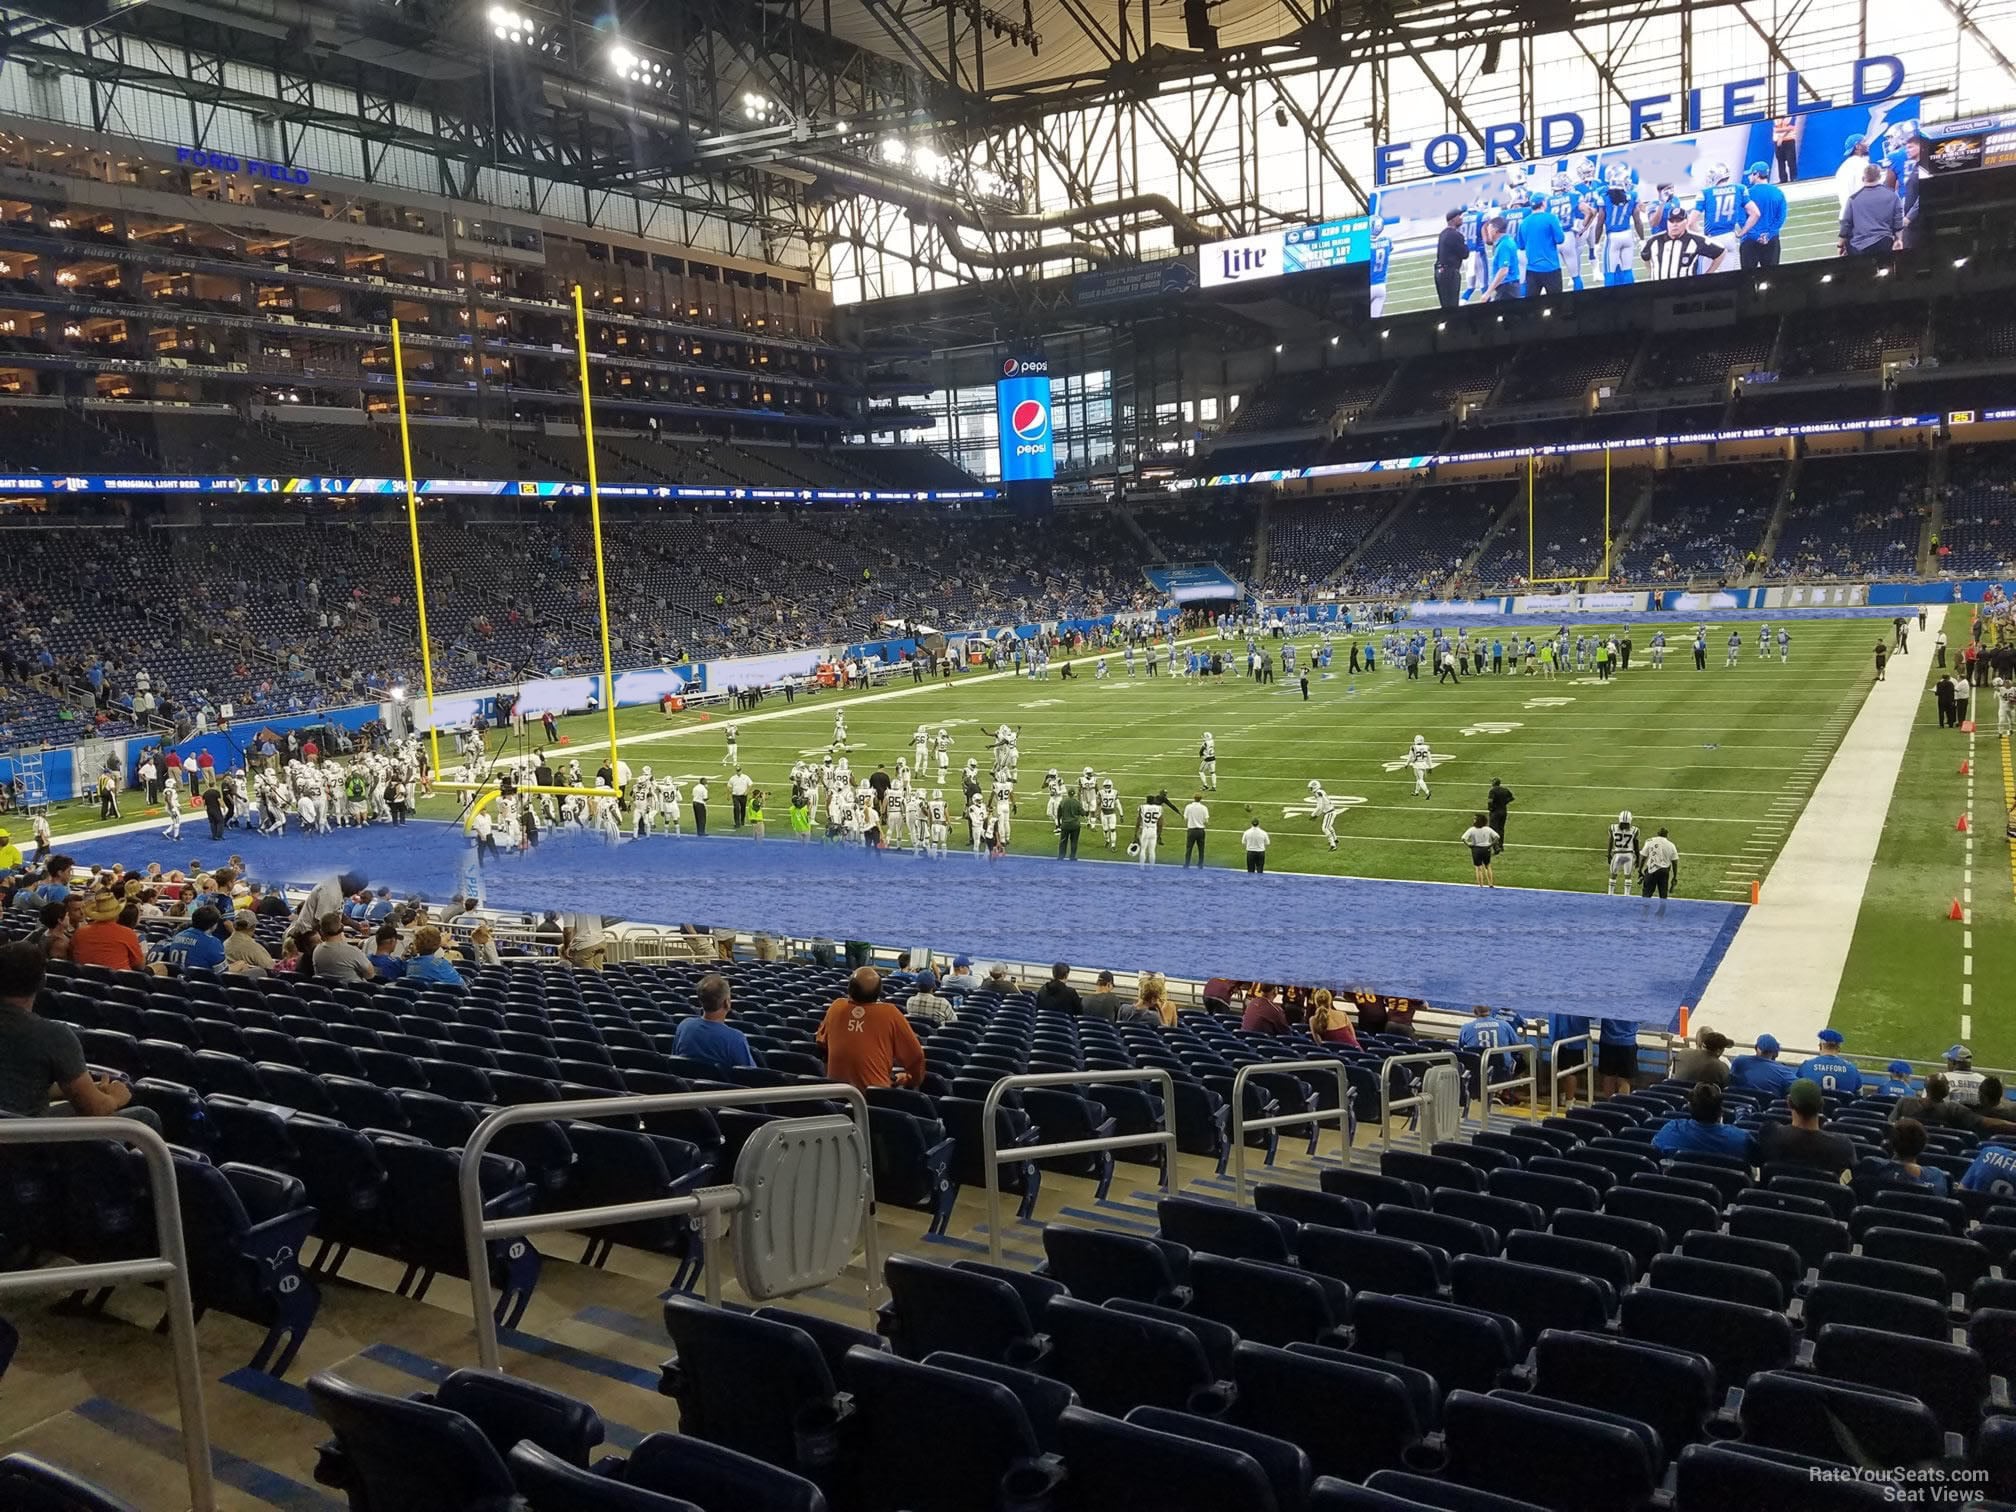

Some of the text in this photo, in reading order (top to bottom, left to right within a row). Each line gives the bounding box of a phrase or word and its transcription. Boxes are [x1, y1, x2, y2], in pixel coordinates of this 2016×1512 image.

[1374, 55, 1905, 186] FORD FIELD
[176, 147, 311, 185] FORD FIELD
[1714, 194, 1735, 223] 14
[1222, 247, 1267, 279] Lite
[89, 306, 113, 315] DICK
[98, 363, 123, 372] DICK
[1021, 360, 1048, 373] pepsi
[1953, 413, 1969, 422] 25
[1800, 423, 1840, 433] ORIGINAL
[1842, 421, 1867, 430] LIGHT
[1868, 419, 1891, 428] BEER
[1679, 433, 1717, 442] ORIGINAL
[1718, 431, 1741, 439] LIGHT
[1743, 428, 1764, 437] BEER
[1016, 443, 1047, 457] pepsi
[1566, 443, 1601, 452] ORIGINAL
[1603, 440, 1625, 449] LIGHT
[1626, 438, 1646, 447] BEER
[1459, 452, 1493, 461] ORIGINAL
[1494, 450, 1515, 459] LIGHT
[18, 479, 43, 488] BEER
[117, 480, 154, 489] ORIGINAL
[155, 480, 178, 489] LIGHT
[179, 480, 200, 489] BEER
[997, 789, 1010, 801] 49
[889, 797, 901, 808] 85
[1102, 798, 1114, 809] 37
[934, 808, 941, 820] 6
[1144, 811, 1159, 824] 95
[1614, 833, 1633, 848] 27
[848, 1020, 865, 1032] 5K
[1478, 1030, 1499, 1048] 81
[1813, 1064, 1847, 1073] STAFFORD
